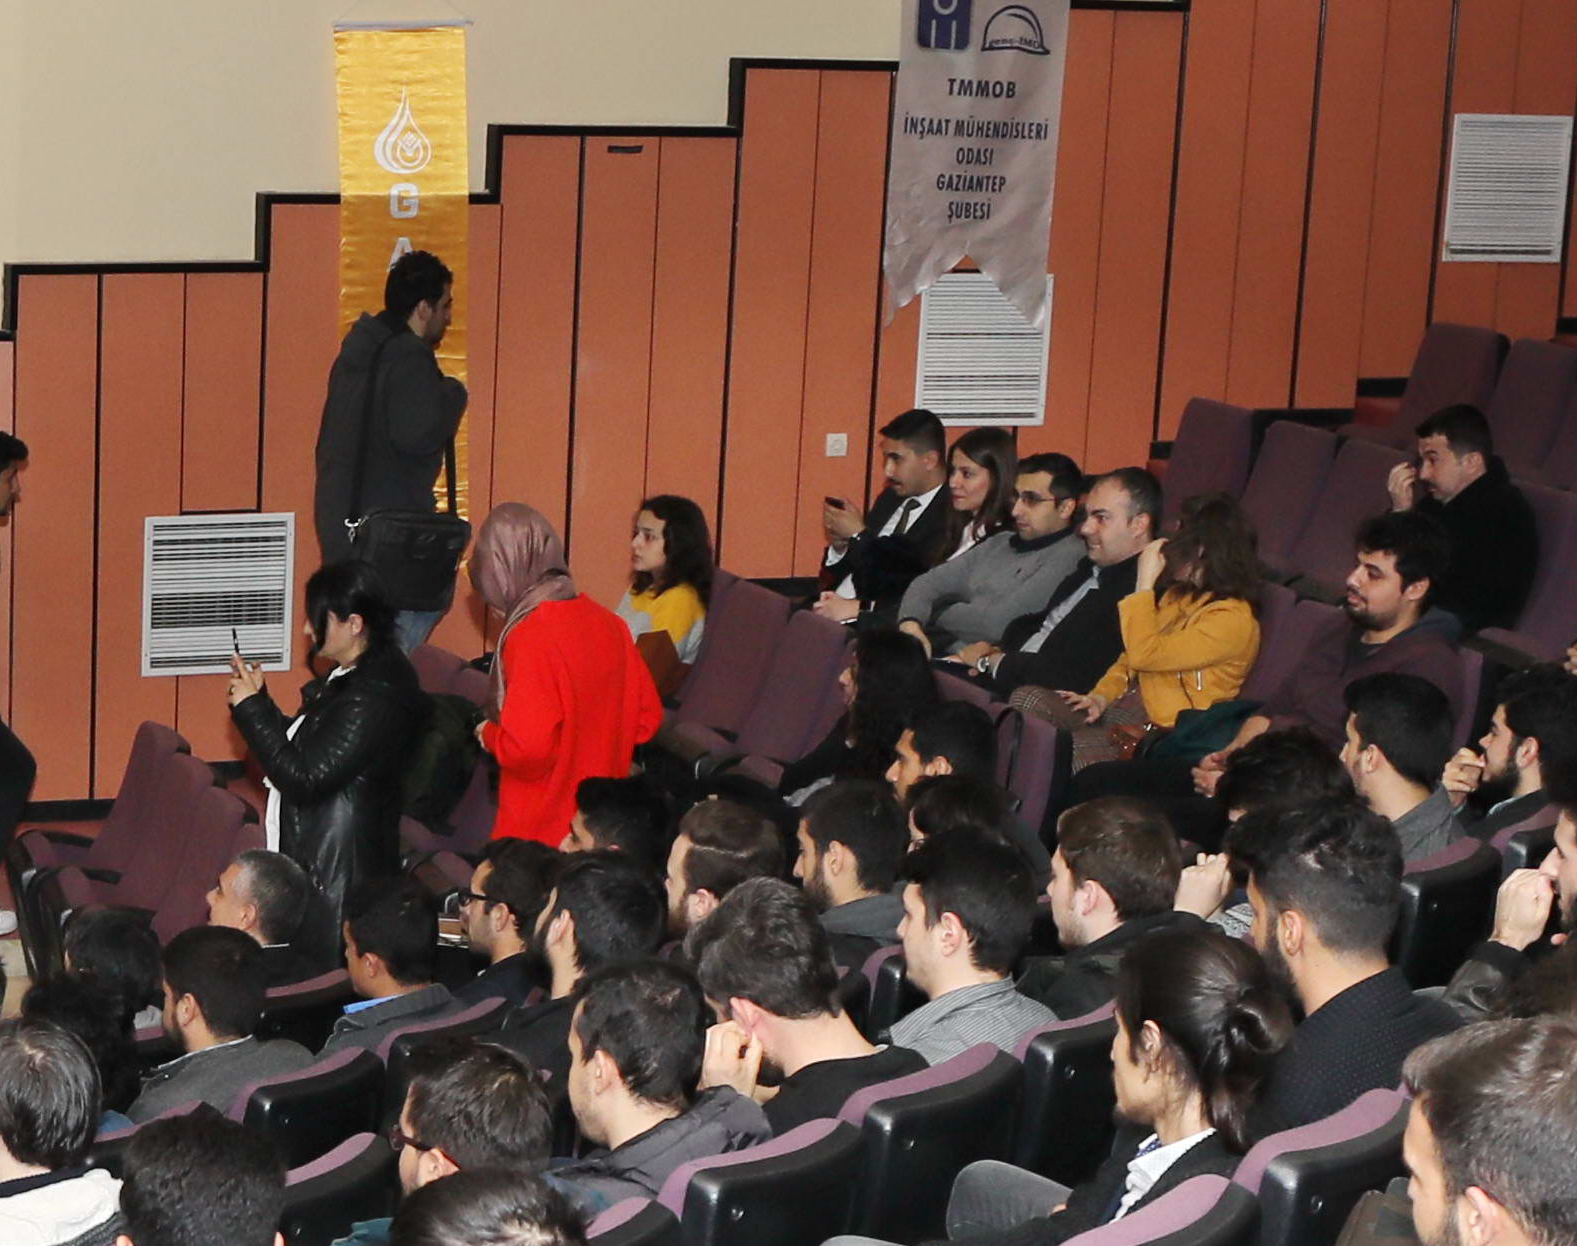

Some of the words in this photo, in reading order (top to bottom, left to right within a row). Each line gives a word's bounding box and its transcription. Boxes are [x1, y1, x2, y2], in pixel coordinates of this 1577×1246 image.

[948, 78, 1016, 98] TMMOB
[904, 112, 951, 139] İNŞAAT
[954, 115, 1049, 140] MÜHENDİSLERİ
[956, 148, 994, 165] ODASI
[937, 170, 1006, 193] GAZİANTEP
[948, 199, 992, 223] ŞUBESİ
